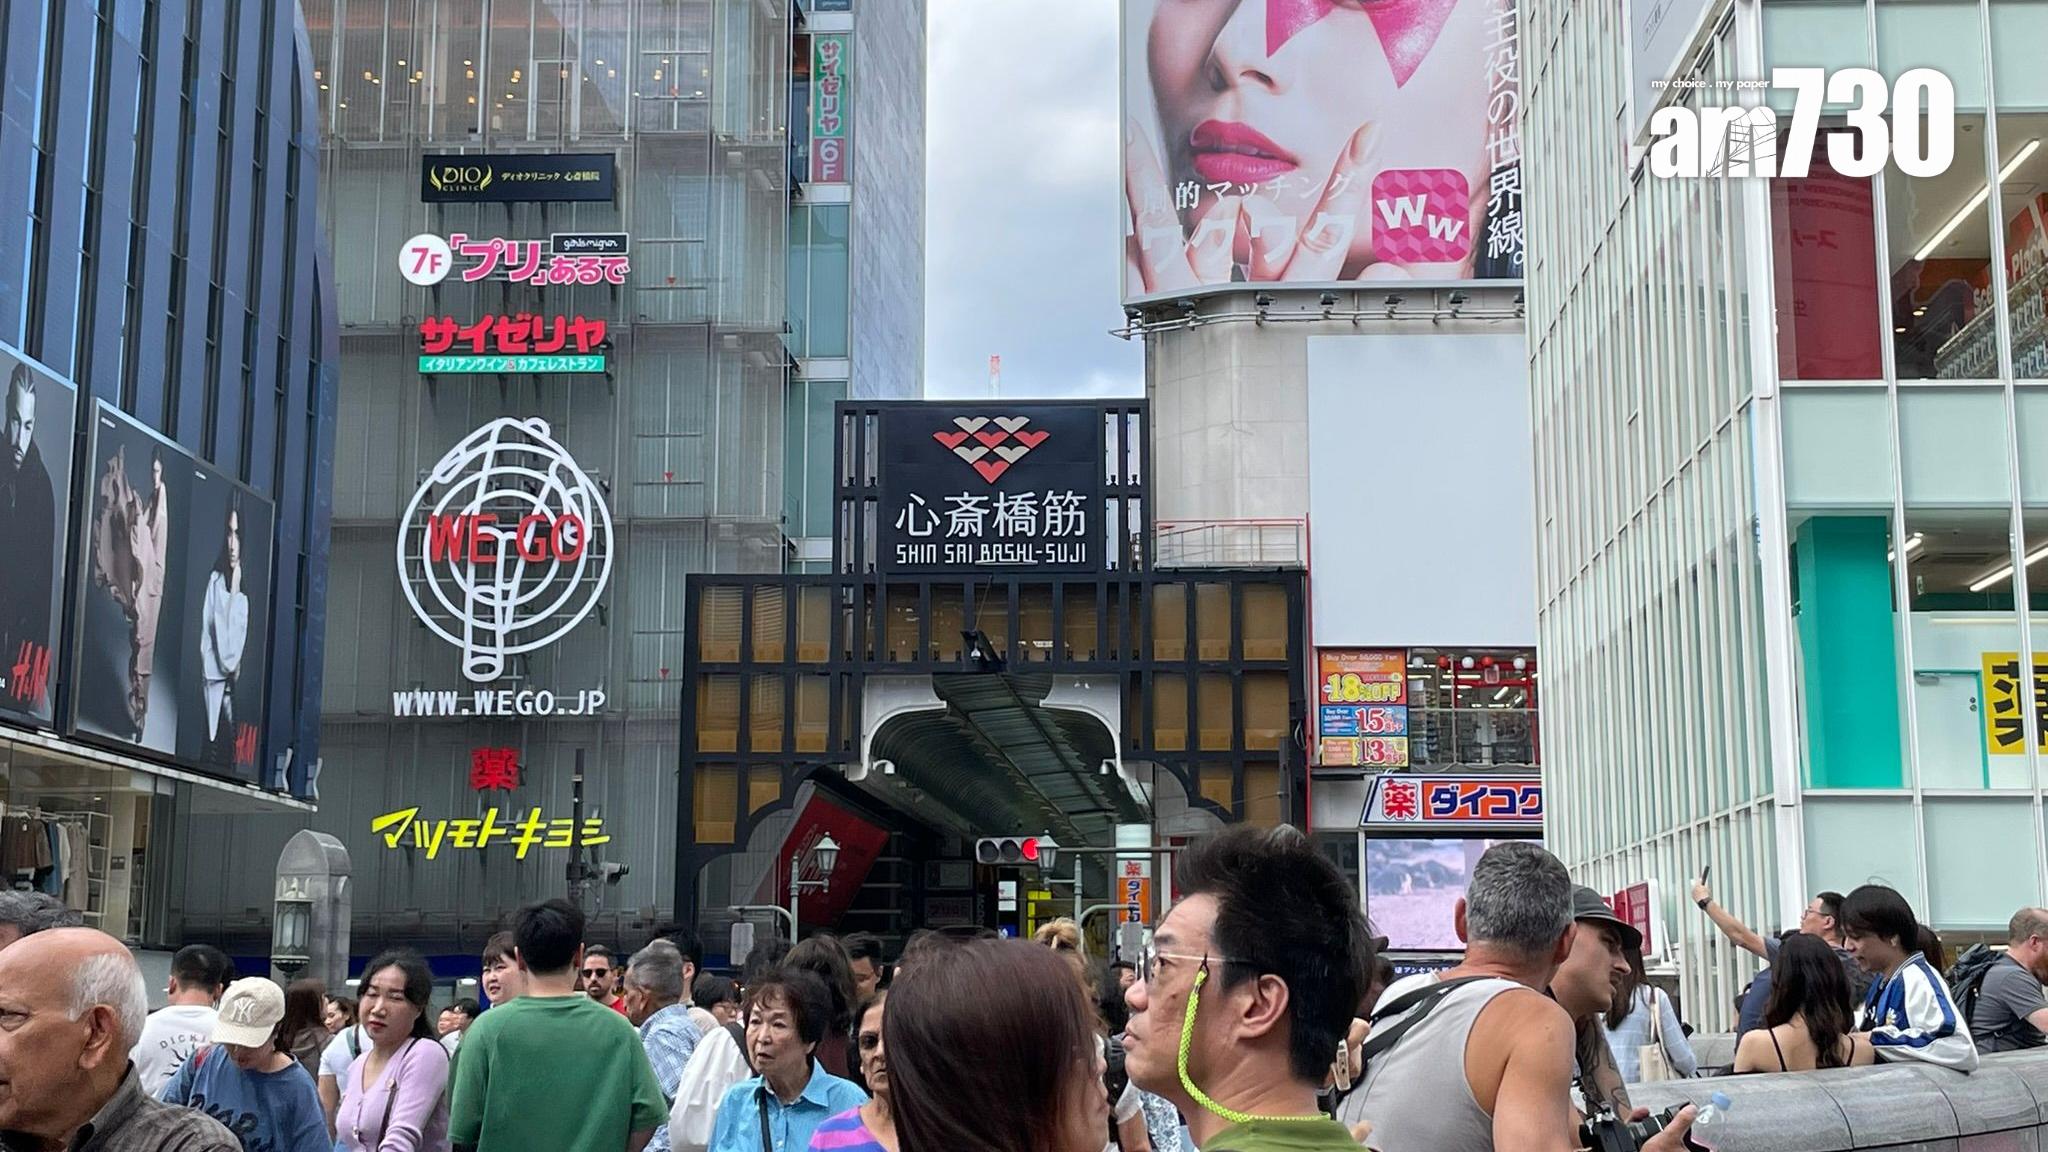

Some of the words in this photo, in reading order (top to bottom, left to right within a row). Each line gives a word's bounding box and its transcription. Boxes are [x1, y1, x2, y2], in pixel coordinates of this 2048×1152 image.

[820, 41, 840, 133] サイゼリヤ
[442, 166, 481, 183] DIO
[820, 139, 839, 181] 6F
[442, 184, 480, 192] CLINIC
[410, 246, 443, 275] 7F
[420, 312, 606, 354] サイゼリヤ
[895, 490, 1087, 538] 心斎橋筋
[430, 514, 497, 563] WE
[516, 514, 585, 562] GO
[896, 544, 937, 564] SHIN
[944, 544, 973, 564] SAI
[393, 690, 606, 716] WWW.WEGO.JP
[470, 748, 519, 791] 薬
[1383, 778, 1417, 819] 薬
[1431, 784, 1542, 816] ダイコク
[371, 807, 610, 860] マツモトキヨシ
[232, 996, 257, 1024] NY
